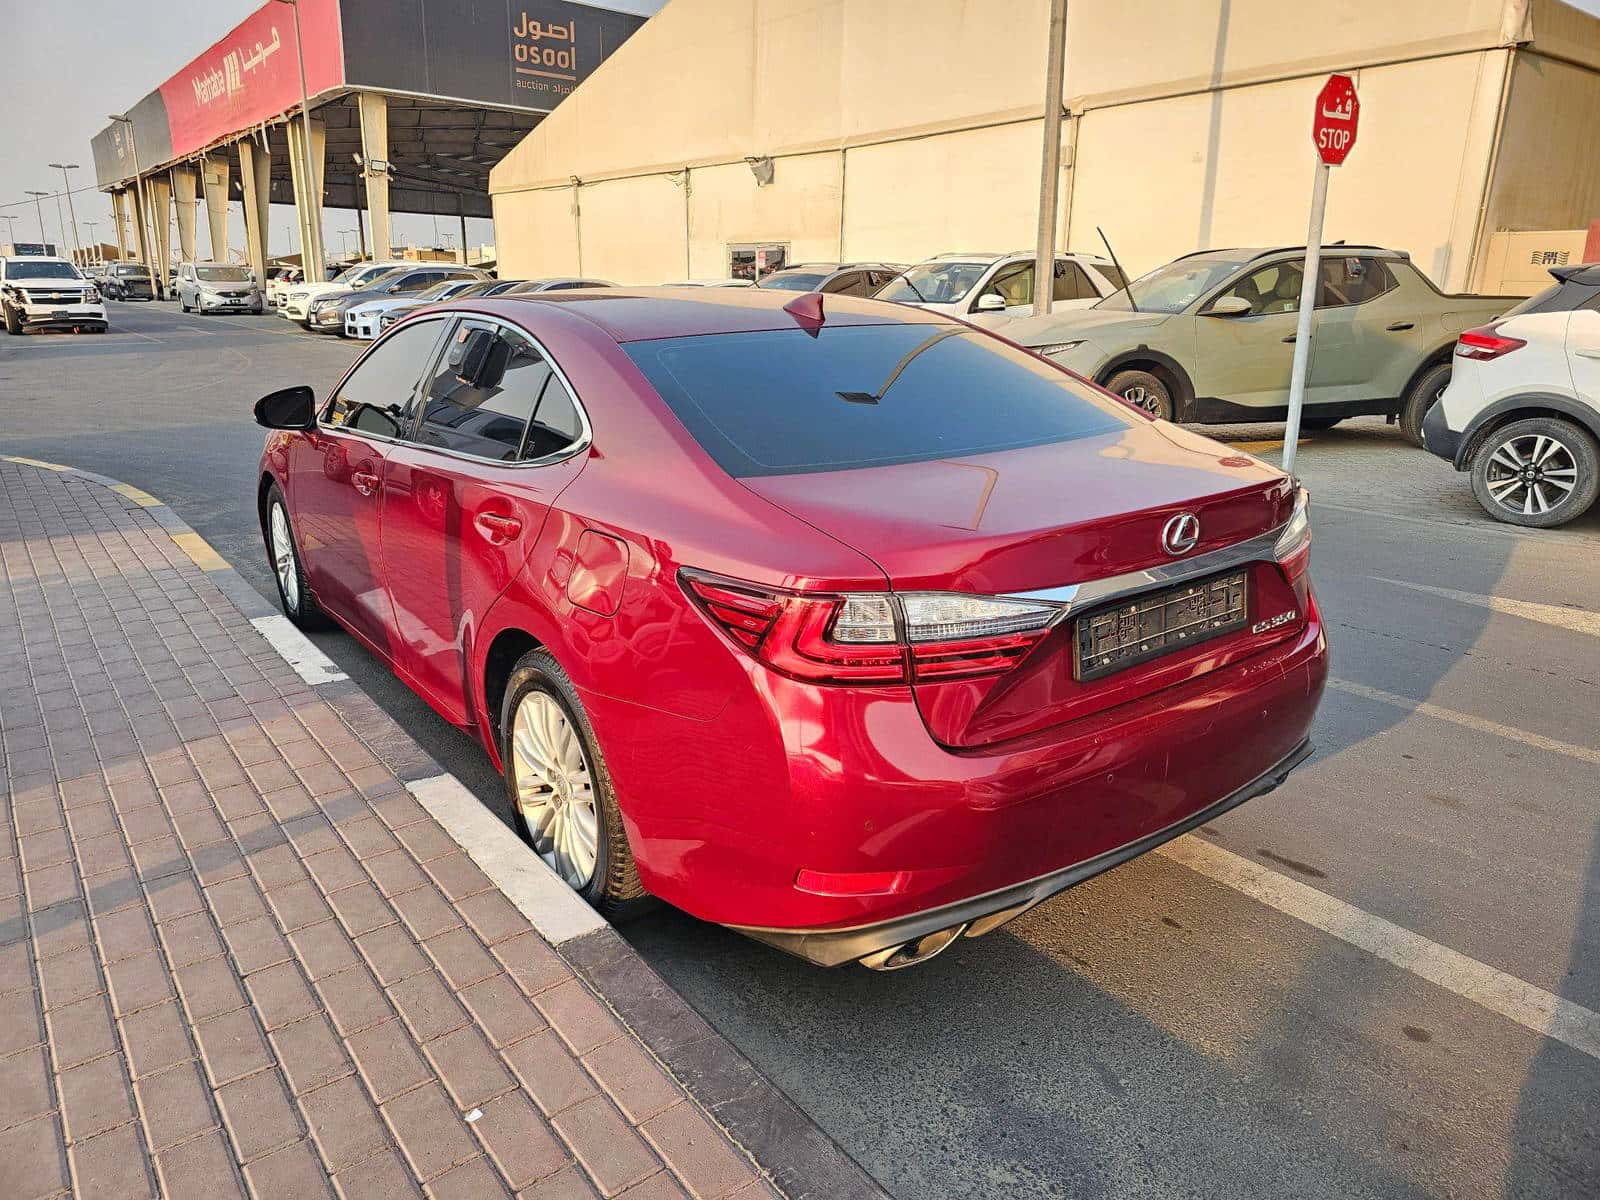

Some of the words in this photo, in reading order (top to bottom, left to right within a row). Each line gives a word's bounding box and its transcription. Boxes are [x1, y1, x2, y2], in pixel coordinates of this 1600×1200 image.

[516, 79, 549, 91] auction
[1322, 89, 1353, 120] قف
[1319, 128, 1350, 150] STOP
